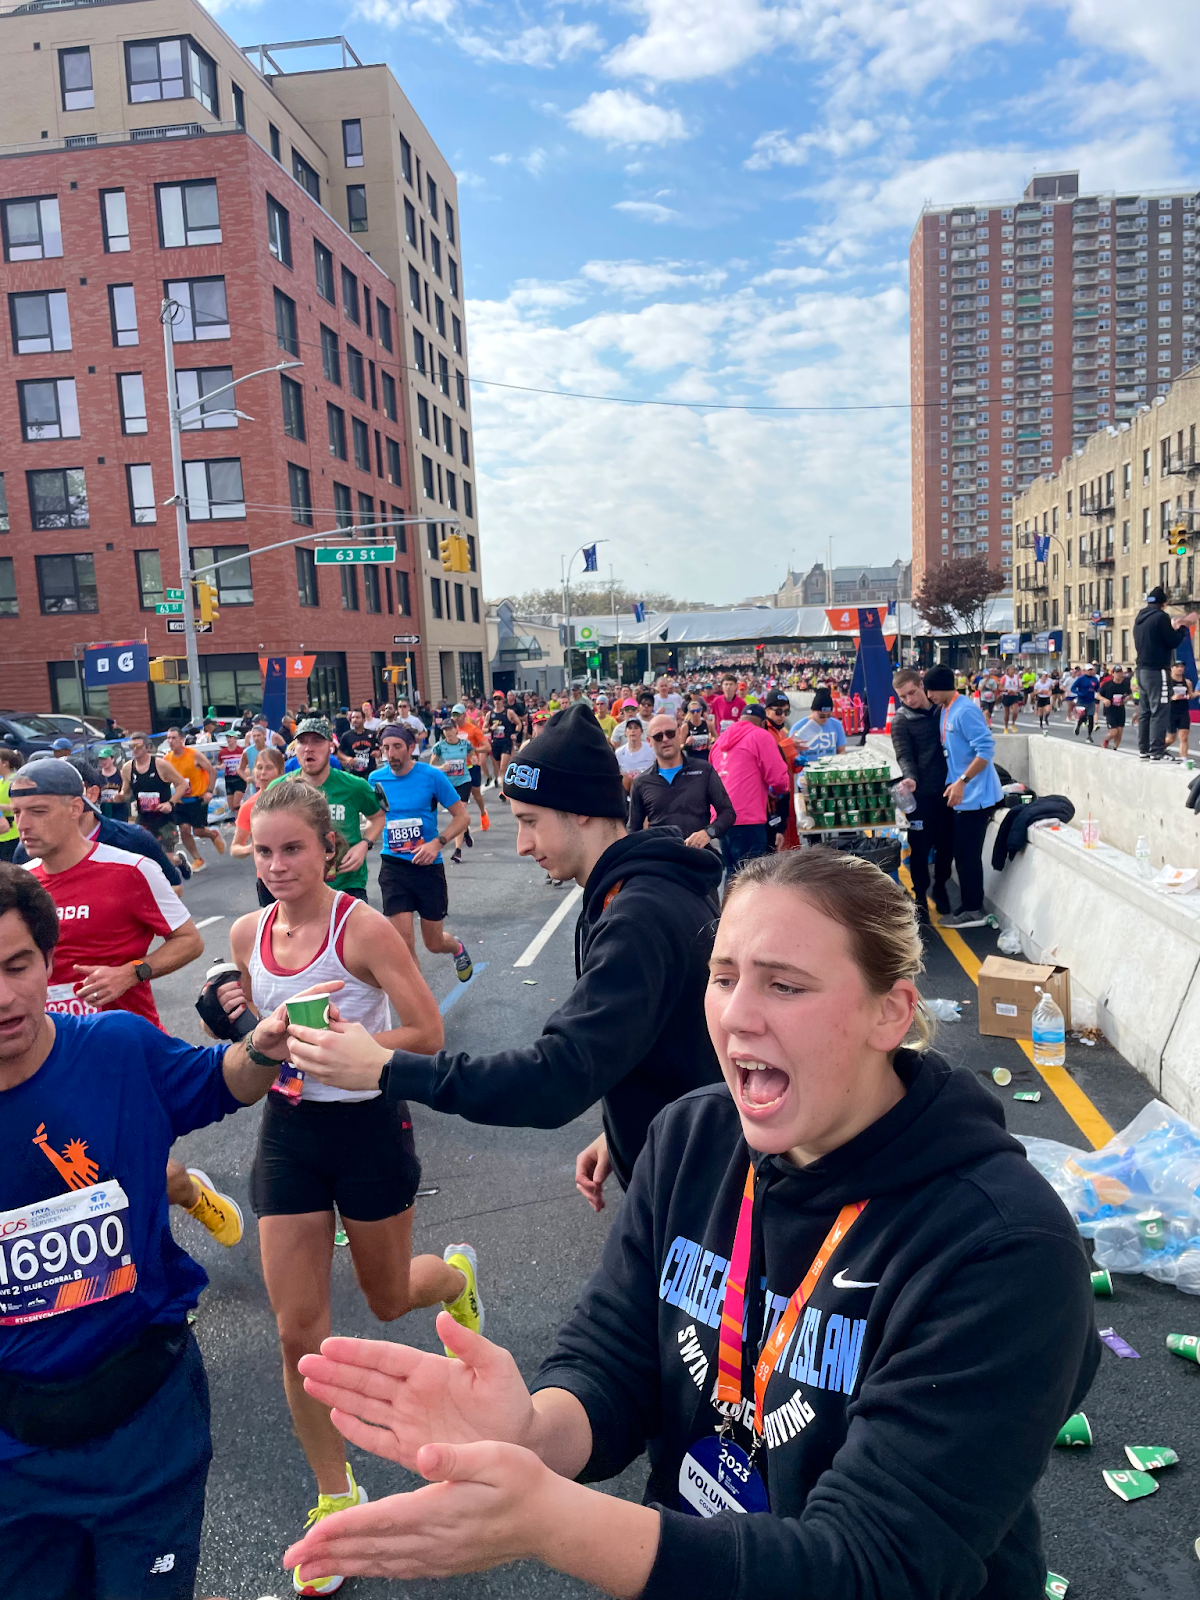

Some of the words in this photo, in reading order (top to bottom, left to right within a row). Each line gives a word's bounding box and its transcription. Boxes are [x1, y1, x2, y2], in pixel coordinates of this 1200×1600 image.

[336, 551, 353, 561] 63
[359, 550, 376, 560] St
[160, 604, 170, 614] 63
[840, 612, 850, 622] 4
[117, 651, 134, 672] G
[293, 660, 303, 670] 4
[503, 762, 540, 791] CSI
[391, 826, 421, 841] 18816
[30, 1207, 50, 1217] TATA
[31, 1204, 77, 1223] CONSULTANCY
[89, 1202, 111, 1212] TATA
[31, 1215, 62, 1228] SERVICES
[1146, 1223, 1158, 1234] G
[0, 1215, 124, 1285] 16900
[12, 1286, 21, 1296] 2
[23, 1282, 43, 1292] BLUE
[43, 1274, 74, 1287] CORRAL
[73, 1269, 83, 1281] B
[1184, 1335, 1197, 1346] G
[763, 1389, 816, 1449] DIVING
[718, 1448, 751, 1483] 2023
[1112, 1473, 1129, 1483] G
[699, 1499, 716, 1516] COUN
[1050, 1581, 1068, 1594] G
